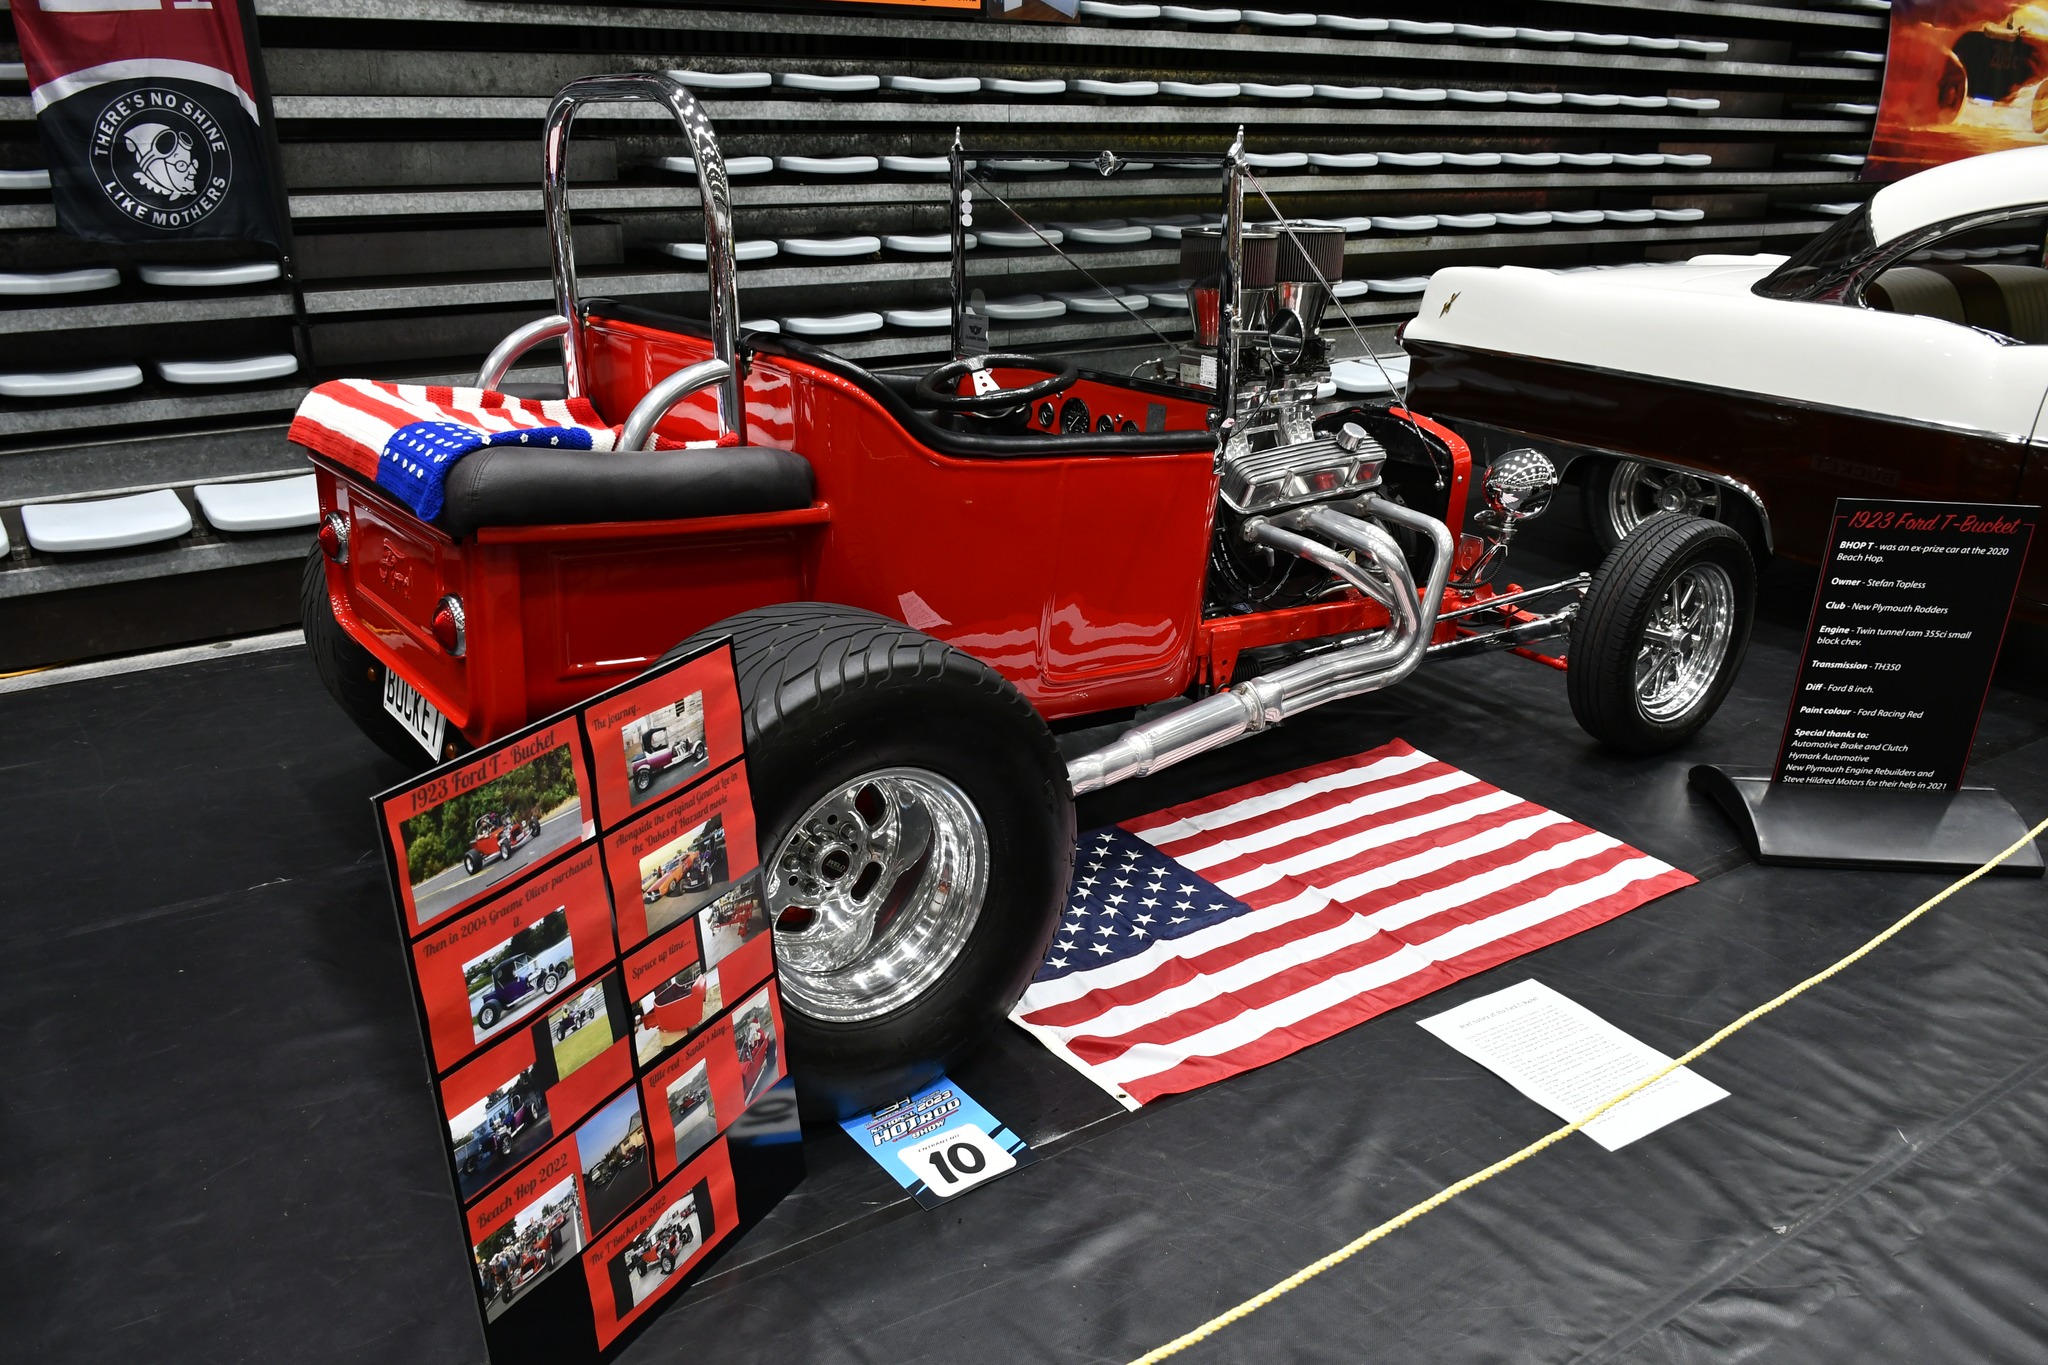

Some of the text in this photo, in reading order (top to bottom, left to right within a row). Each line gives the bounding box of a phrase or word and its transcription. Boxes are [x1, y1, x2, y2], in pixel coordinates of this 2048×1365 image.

[95, 92, 226, 156] THERE'S NO SHINE
[105, 176, 226, 226] LIKE MOTHERS
[1848, 511, 2022, 534] 1923 Ford T-Bucket
[1839, 541, 1867, 550] BHOP
[1867, 542, 1875, 550] T
[1911, 545, 1943, 554] ex-prize
[1971, 547, 1985, 555] the
[1986, 548, 2009, 556] 2020
[1836, 553, 1885, 564] Beach Hop.
[1831, 577, 1861, 586] Owner
[1866, 578, 1895, 588] Stefan
[1895, 580, 1926, 590] Topless
[1825, 601, 1846, 610] Club
[1851, 603, 1871, 611] New
[1872, 603, 1913, 613] Plymouth
[1913, 605, 1948, 614] Rodders
[1819, 625, 1850, 635] Engine
[1856, 627, 1876, 635] Twin
[1877, 628, 1905, 637] tunnel
[1924, 630, 1947, 639] 355ci
[1948, 631, 1972, 639] small
[1817, 636, 1862, 646] block chev.
[1811, 660, 1868, 670] Transmission
[1873, 663, 1902, 671] TH350
[1805, 683, 1823, 691] Diff
[1827, 684, 1848, 693] Ford
[1847, 685, 1854, 693] 8
[1854, 685, 1875, 694] inch.
[1799, 706, 1823, 715] Paint
[1824, 707, 1852, 716] colour
[1857, 708, 1877, 717] Ford
[1878, 709, 1906, 719] Racing
[1907, 711, 1924, 719] Red
[592, 717, 606, 731] The
[1794, 728, 1870, 739] Special thanks to:
[1791, 740, 1909, 753] Automotive Brake and Clutch
[1788, 752, 1870, 763] Hymark Automotive
[410, 778, 449, 811] 1923
[451, 764, 487, 793] Ford
[488, 755, 500, 775] T
[510, 731, 555, 765] Bucket
[1785, 763, 1935, 778] New Plymouth Engine Rebuilders and
[1783, 775, 1805, 783] Steve
[1805, 776, 1835, 785] Hildred
[1836, 777, 1865, 786] Motors
[1865, 778, 1878, 787] for
[1879, 779, 1898, 788] their
[1899, 780, 1917, 790] help
[1926, 782, 1947, 790] 2021
[615, 772, 738, 848] Alongside the original General Lee in
[632, 842, 643, 855] the
[671, 821, 678, 835] of
[423, 855, 593, 958] Then in 2004 Graeme Oliver purchased
[513, 916, 523, 929] it.
[632, 959, 657, 980] Spruce
[658, 952, 668, 963] up
[648, 1071, 666, 1088] Little
[667, 1057, 680, 1075] red
[917, 1090, 953, 1113] 2023
[870, 1111, 915, 1135] NATIONAL
[911, 1119, 946, 1140] SHOW
[929, 1143, 986, 1184] 10
[477, 1153, 568, 1229] Beach Hop 2022
[589, 1250, 604, 1267] The
[639, 1213, 648, 1225] in
[647, 1195, 668, 1219] 2022
